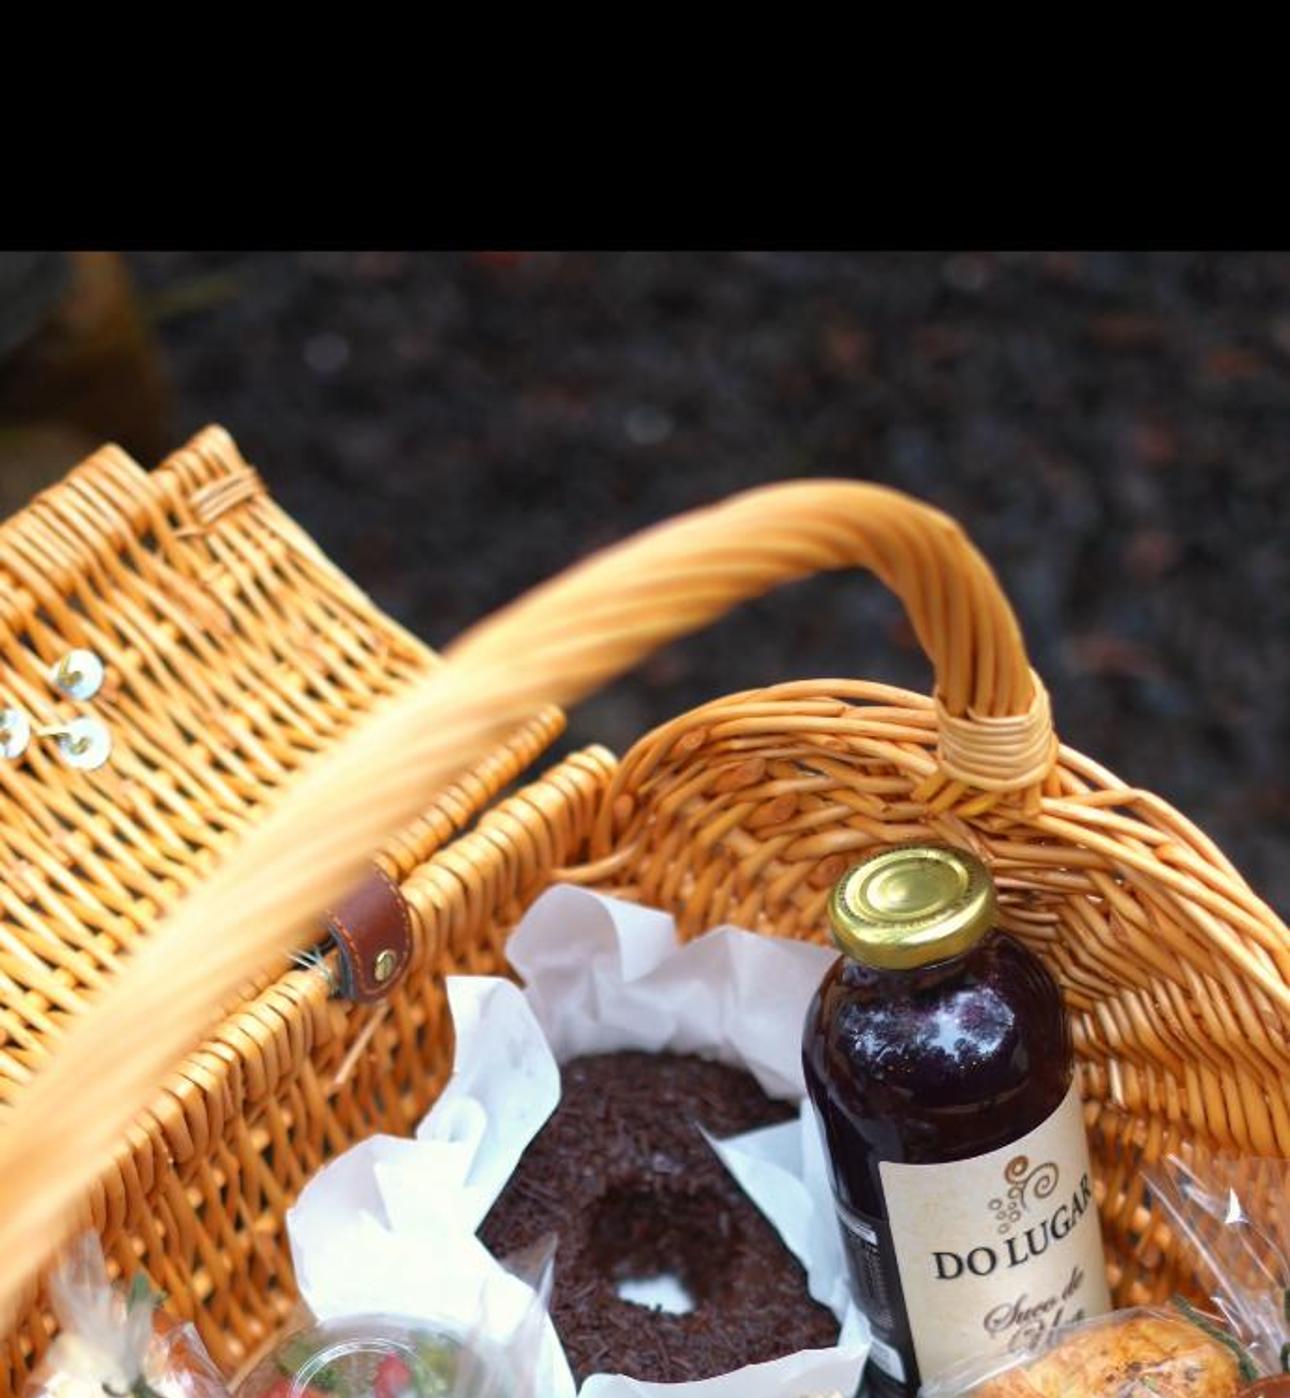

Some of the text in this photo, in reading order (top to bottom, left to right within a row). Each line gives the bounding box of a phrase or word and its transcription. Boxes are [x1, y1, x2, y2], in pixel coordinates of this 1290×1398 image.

[932, 1174, 1092, 1280] DO LUGAR
[983, 1293, 1057, 1339] Suco
